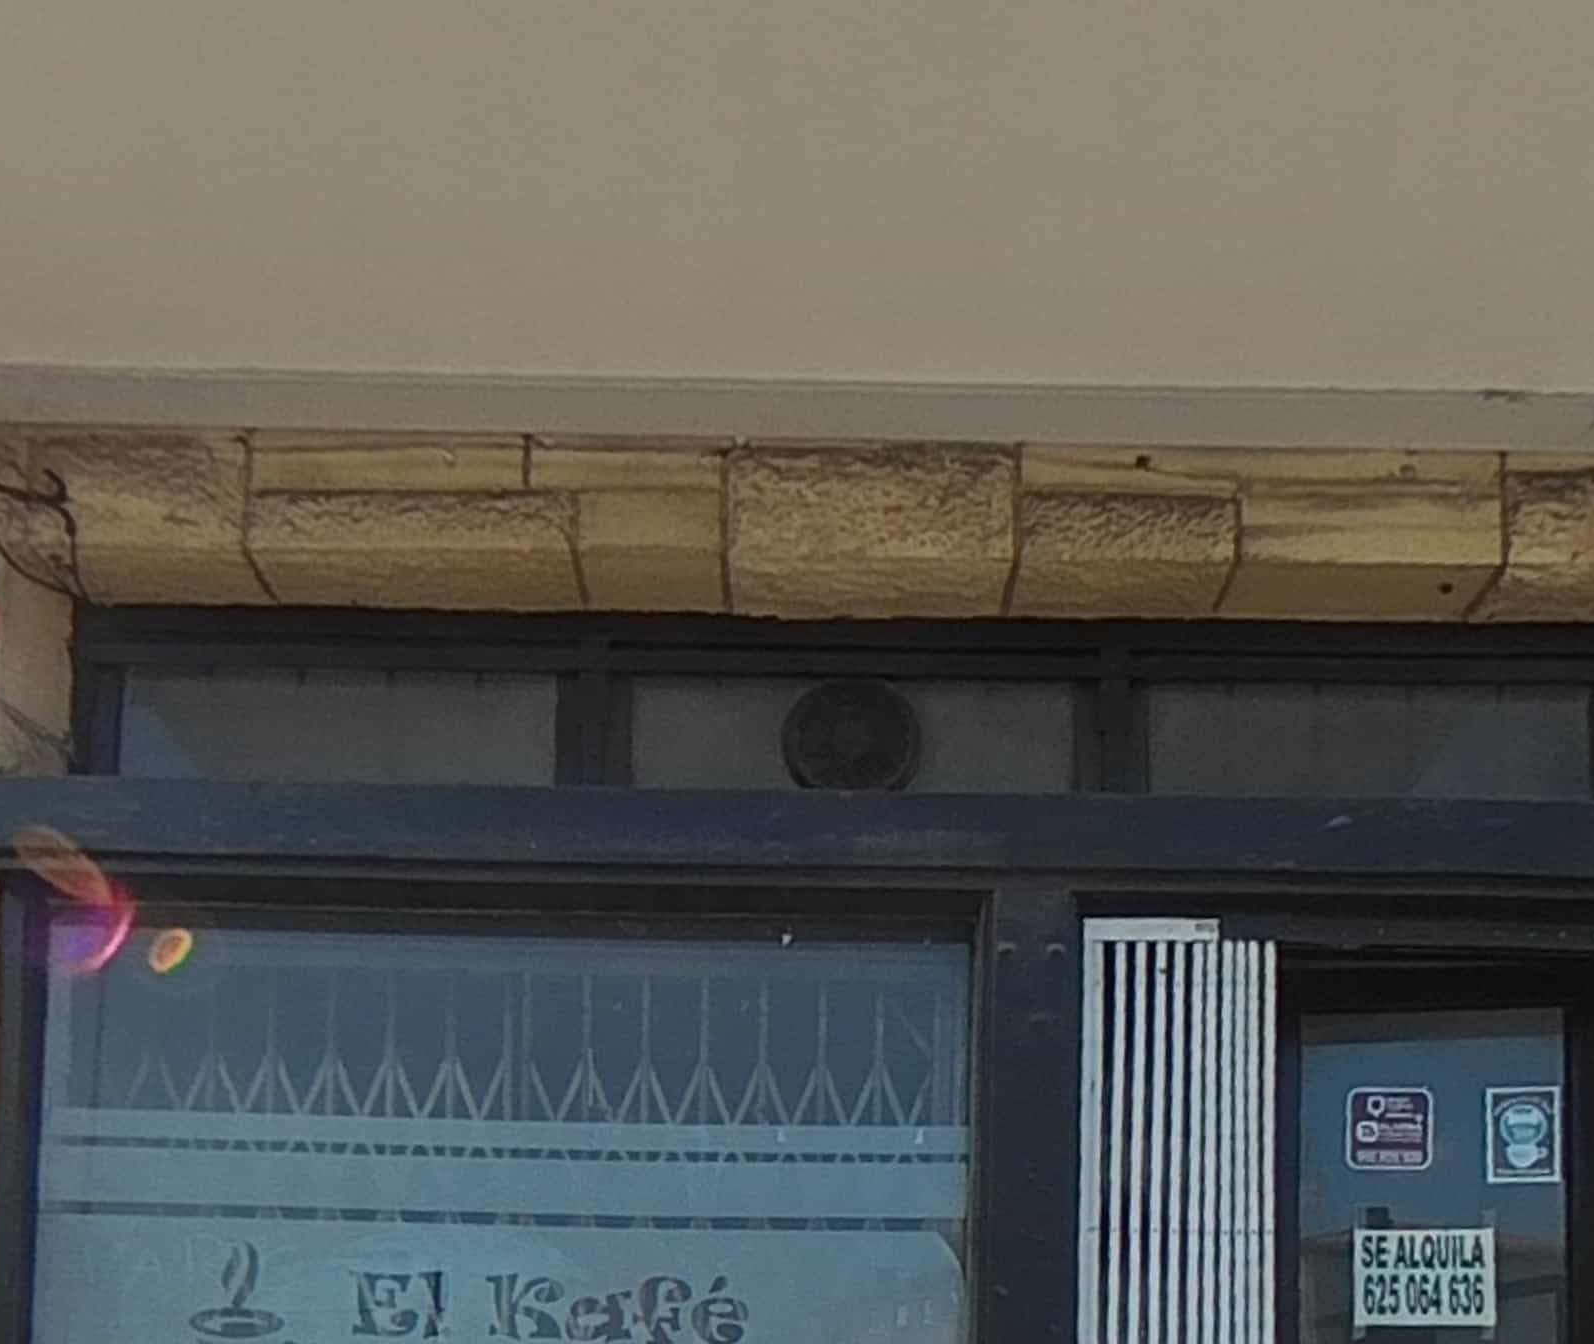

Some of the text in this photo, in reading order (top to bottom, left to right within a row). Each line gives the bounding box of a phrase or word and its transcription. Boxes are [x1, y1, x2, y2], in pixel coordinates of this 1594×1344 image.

[1361, 1233, 1486, 1270] SE ALQUILA
[349, 1270, 447, 1339] El
[1363, 1273, 1485, 1316] 625 064 636
